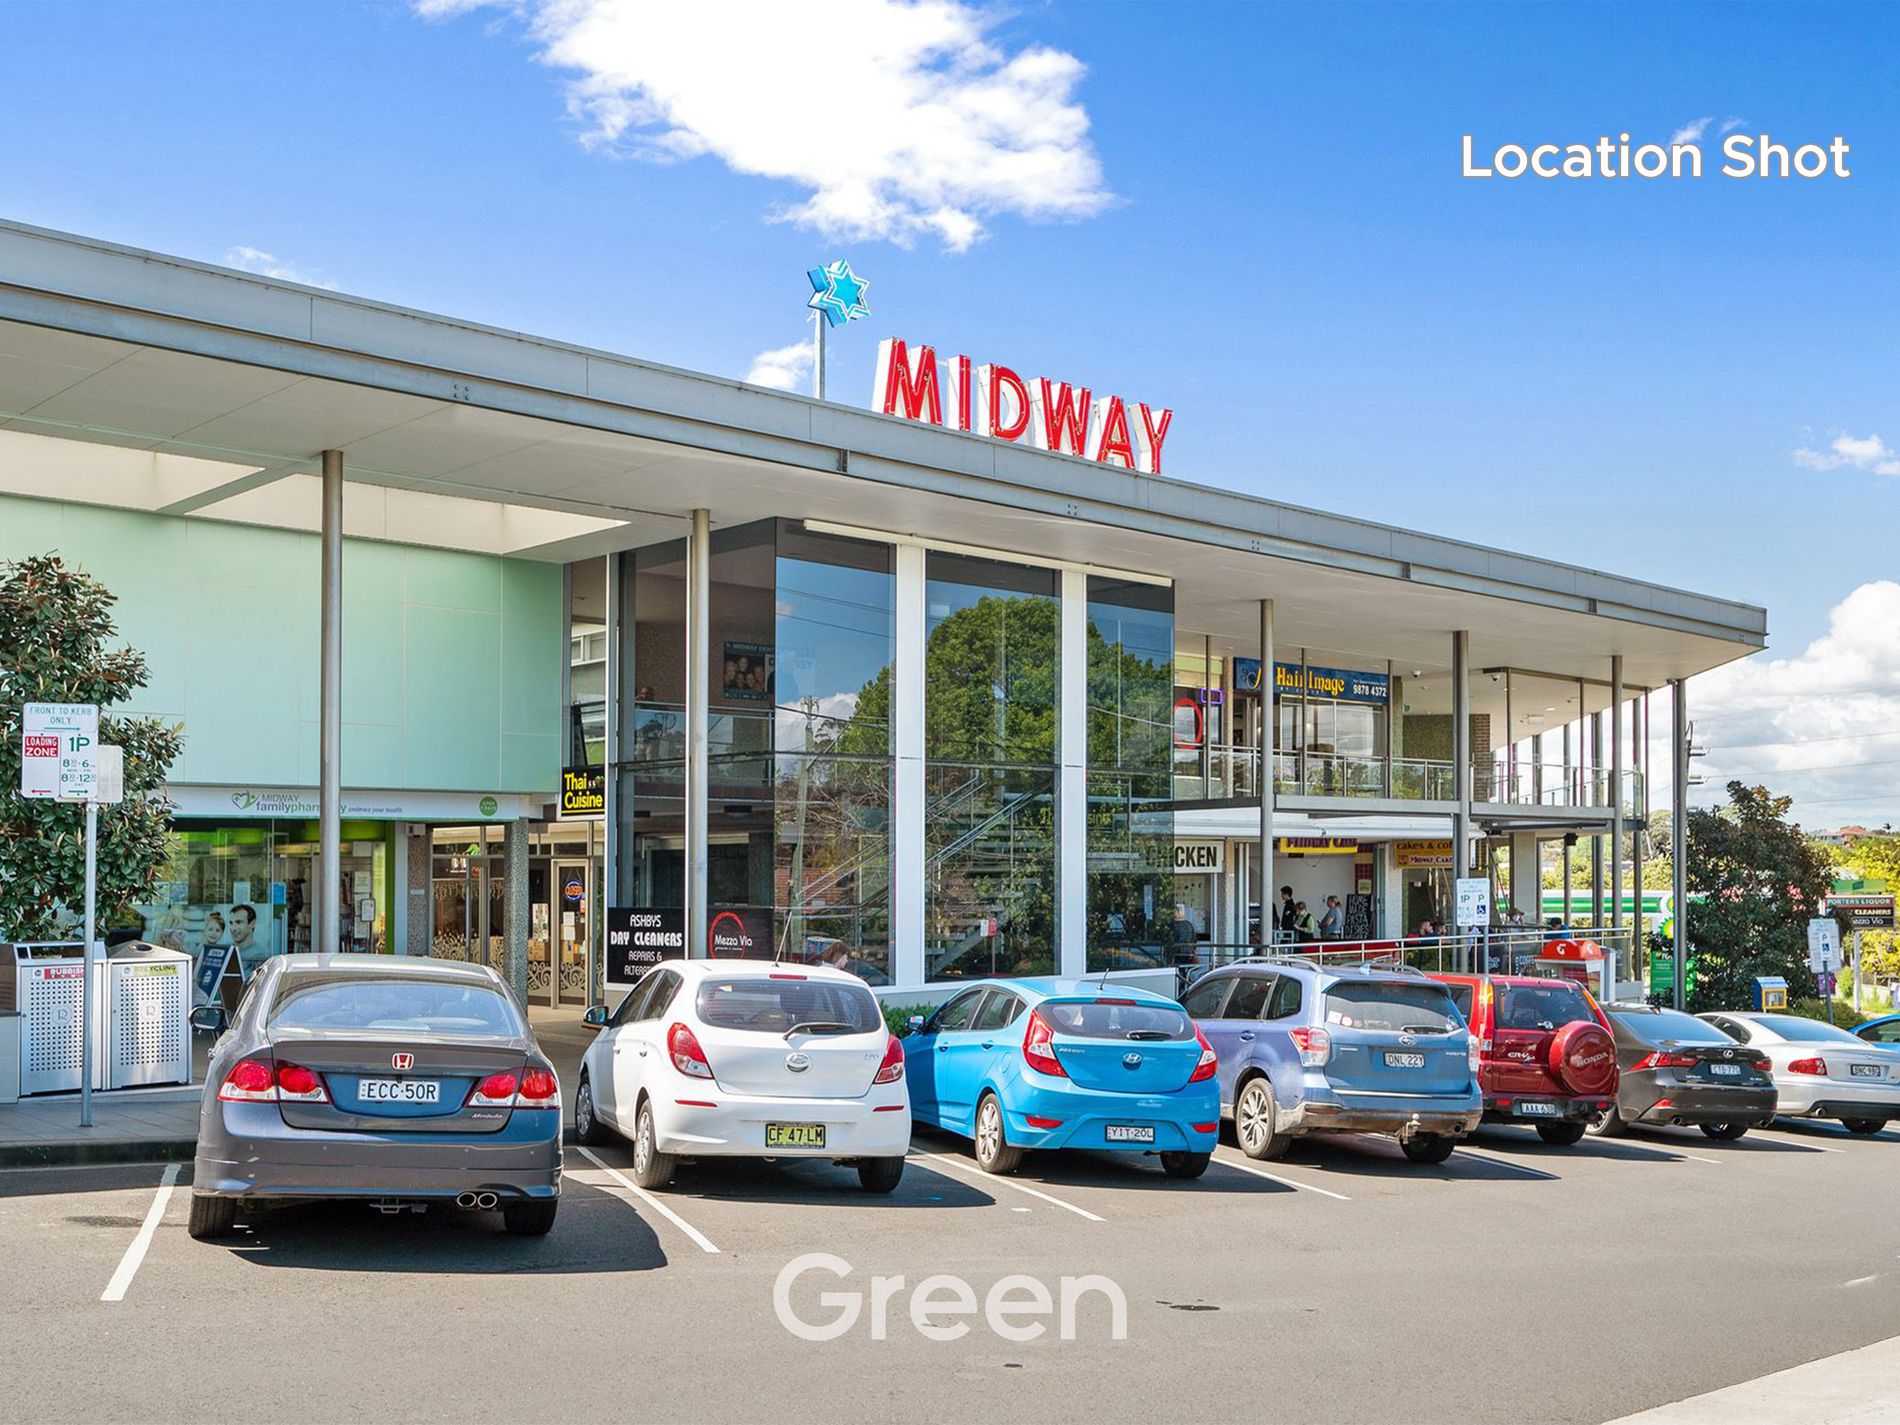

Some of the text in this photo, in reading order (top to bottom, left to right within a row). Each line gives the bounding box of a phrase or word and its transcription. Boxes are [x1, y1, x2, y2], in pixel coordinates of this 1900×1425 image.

[875, 336, 1174, 475] MIDWAY
[1308, 671, 1345, 696] Image
[1353, 684, 1387, 697] 9878 4372
[30, 706, 92, 715] FRONT TO KERB
[50, 716, 72, 724] ONLY
[25, 737, 58, 747] LOADING
[69, 737, 90, 752] 1P
[25, 748, 58, 758] ZONE
[564, 772, 587, 790] Thai
[261, 794, 300, 802] MIDWAY
[564, 791, 603, 809] Cuisine
[256, 801, 347, 814] familyphary
[1397, 841, 1424, 850] cakes
[1427, 842, 1433, 850] &
[1174, 846, 1217, 867] CKEN
[1460, 894, 1485, 903] 1P P
[1854, 908, 1892, 916] CLEANERS
[630, 914, 662, 928] ASHBYS
[610, 931, 683, 947] DRY CLEANERS
[714, 934, 753, 947] Mezza Via
[628, 951, 663, 962] REPAIRS &
[134, 964, 176, 972] RECYCLING
[1577, 1052, 1608, 1067] HONDA
